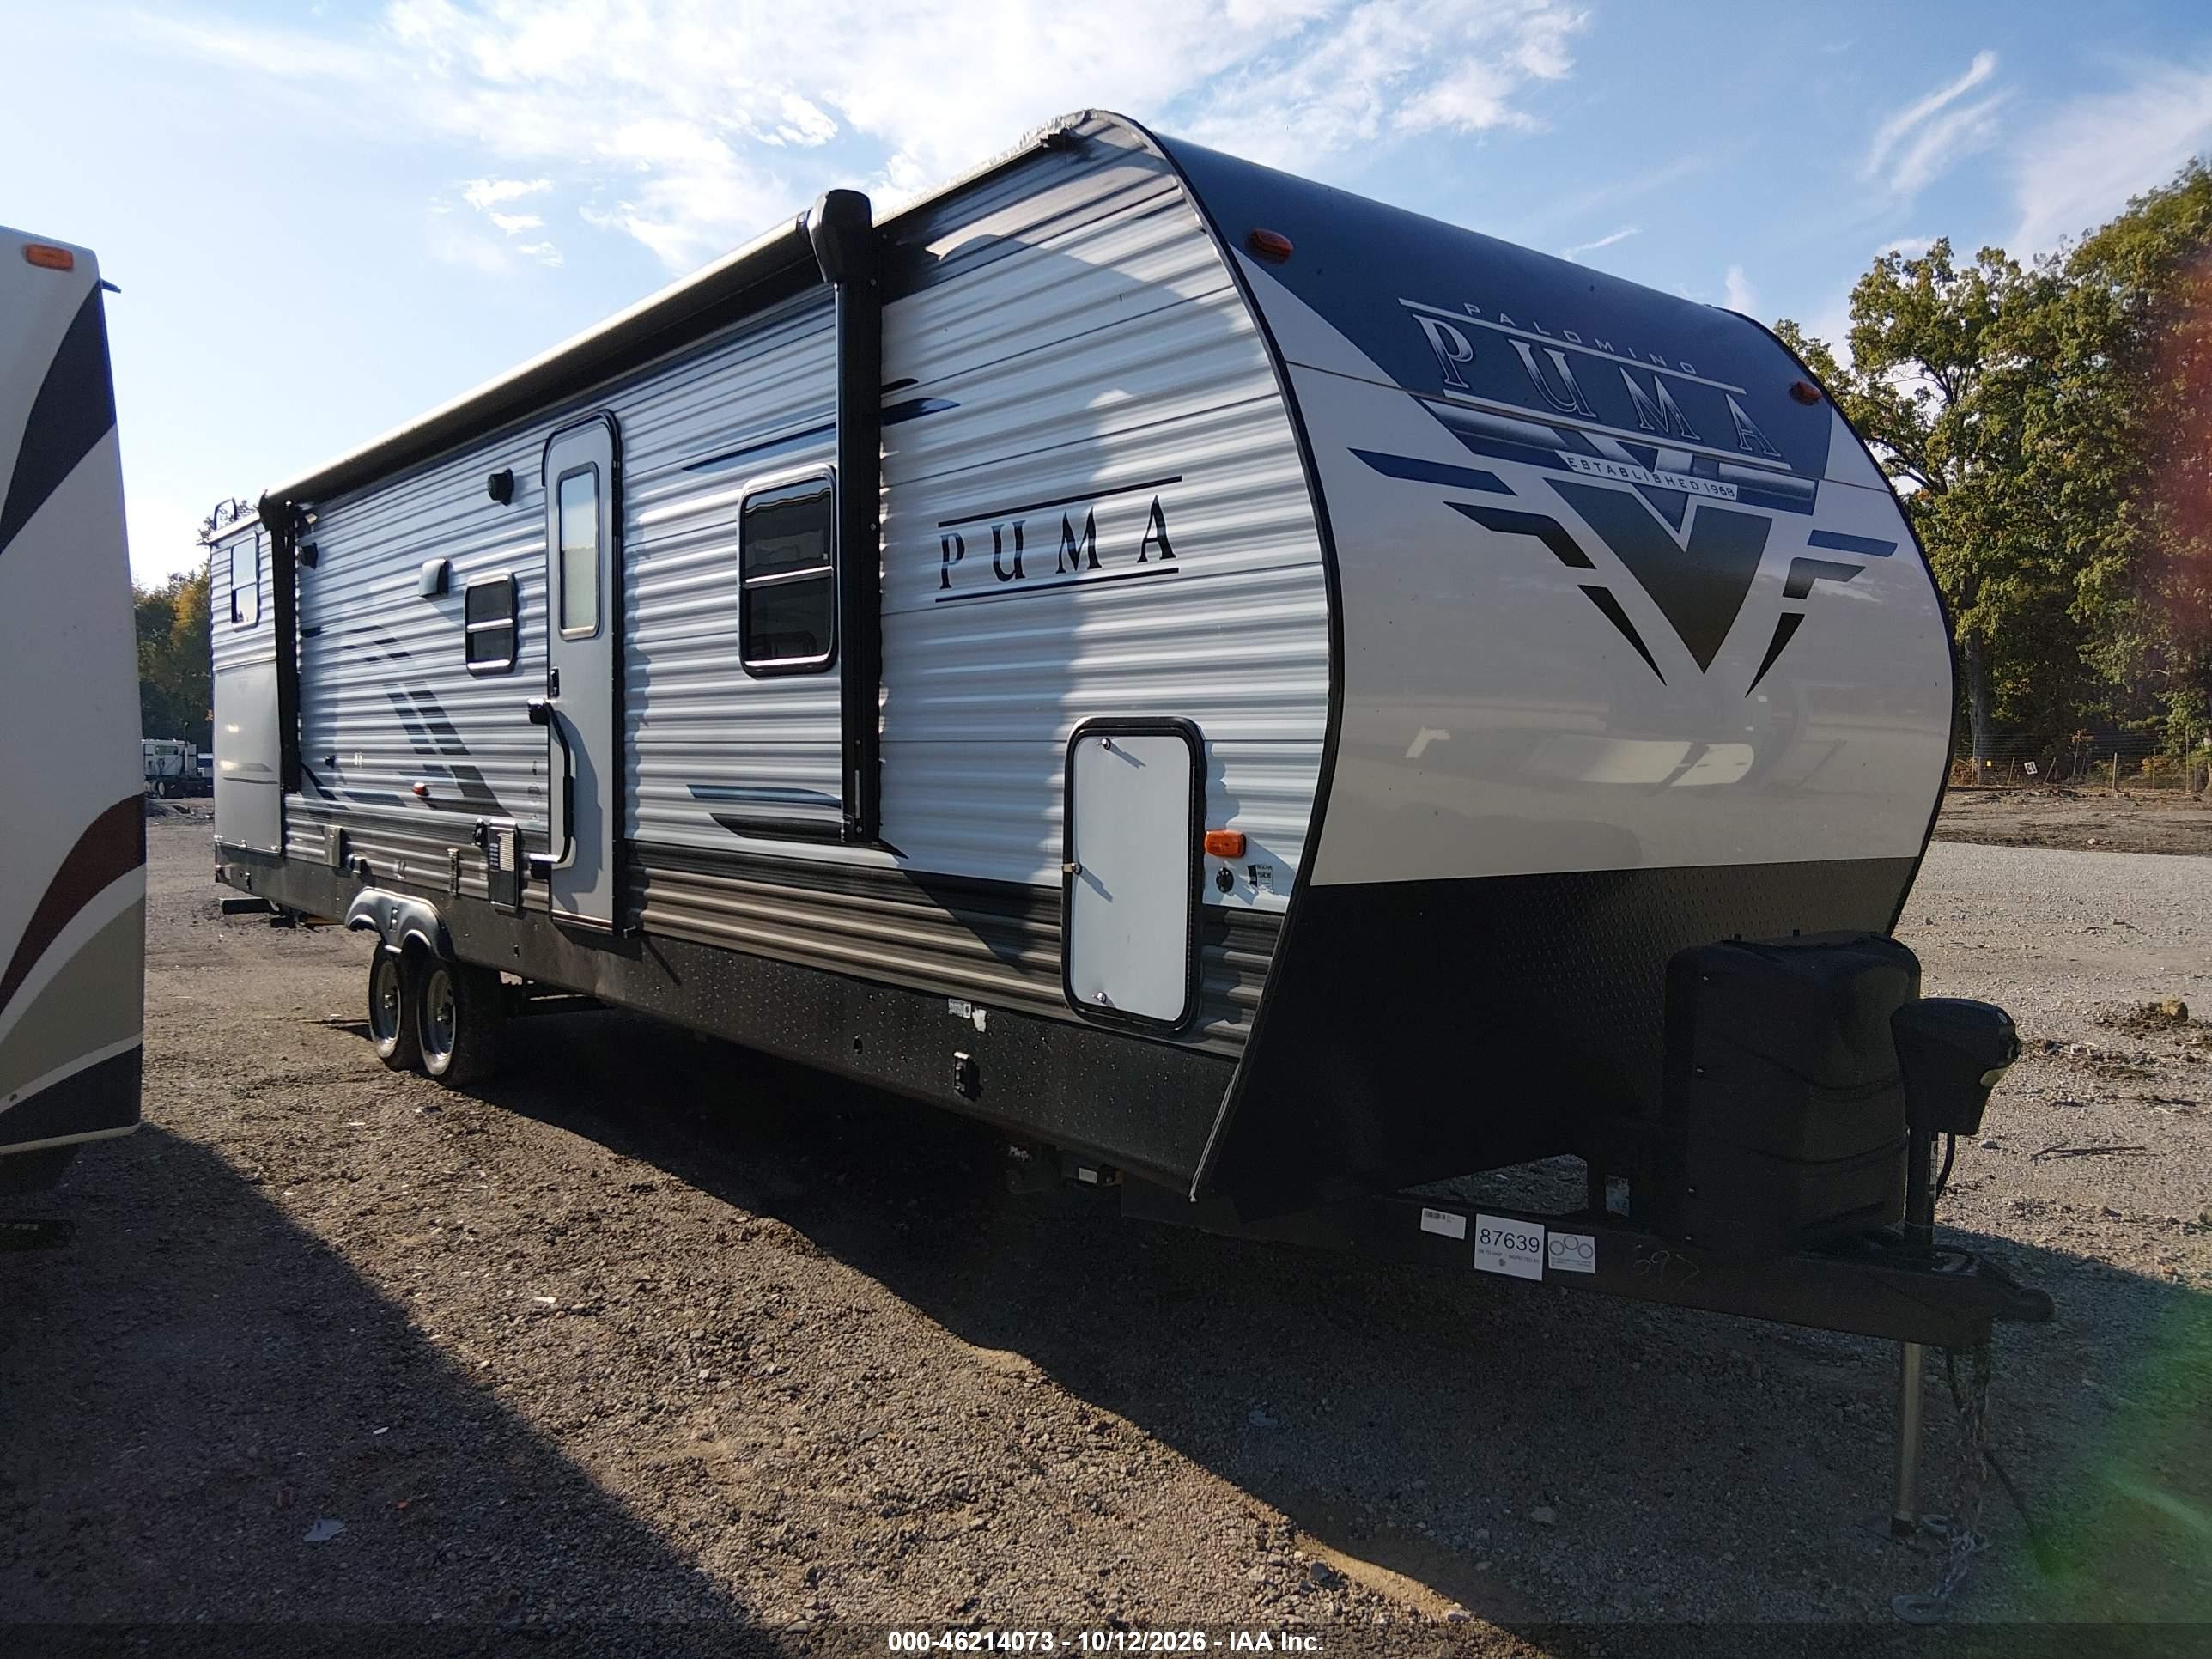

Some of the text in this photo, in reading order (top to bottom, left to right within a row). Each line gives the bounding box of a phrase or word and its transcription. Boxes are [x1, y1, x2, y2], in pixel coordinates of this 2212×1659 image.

[1463, 301, 1698, 375] PALOMINO
[1411, 313, 1783, 458] PUMA
[1566, 456, 1736, 498] ESTABLISHED 1968
[939, 494, 1177, 591] PUMA
[1480, 1228, 1540, 1254] 87639
